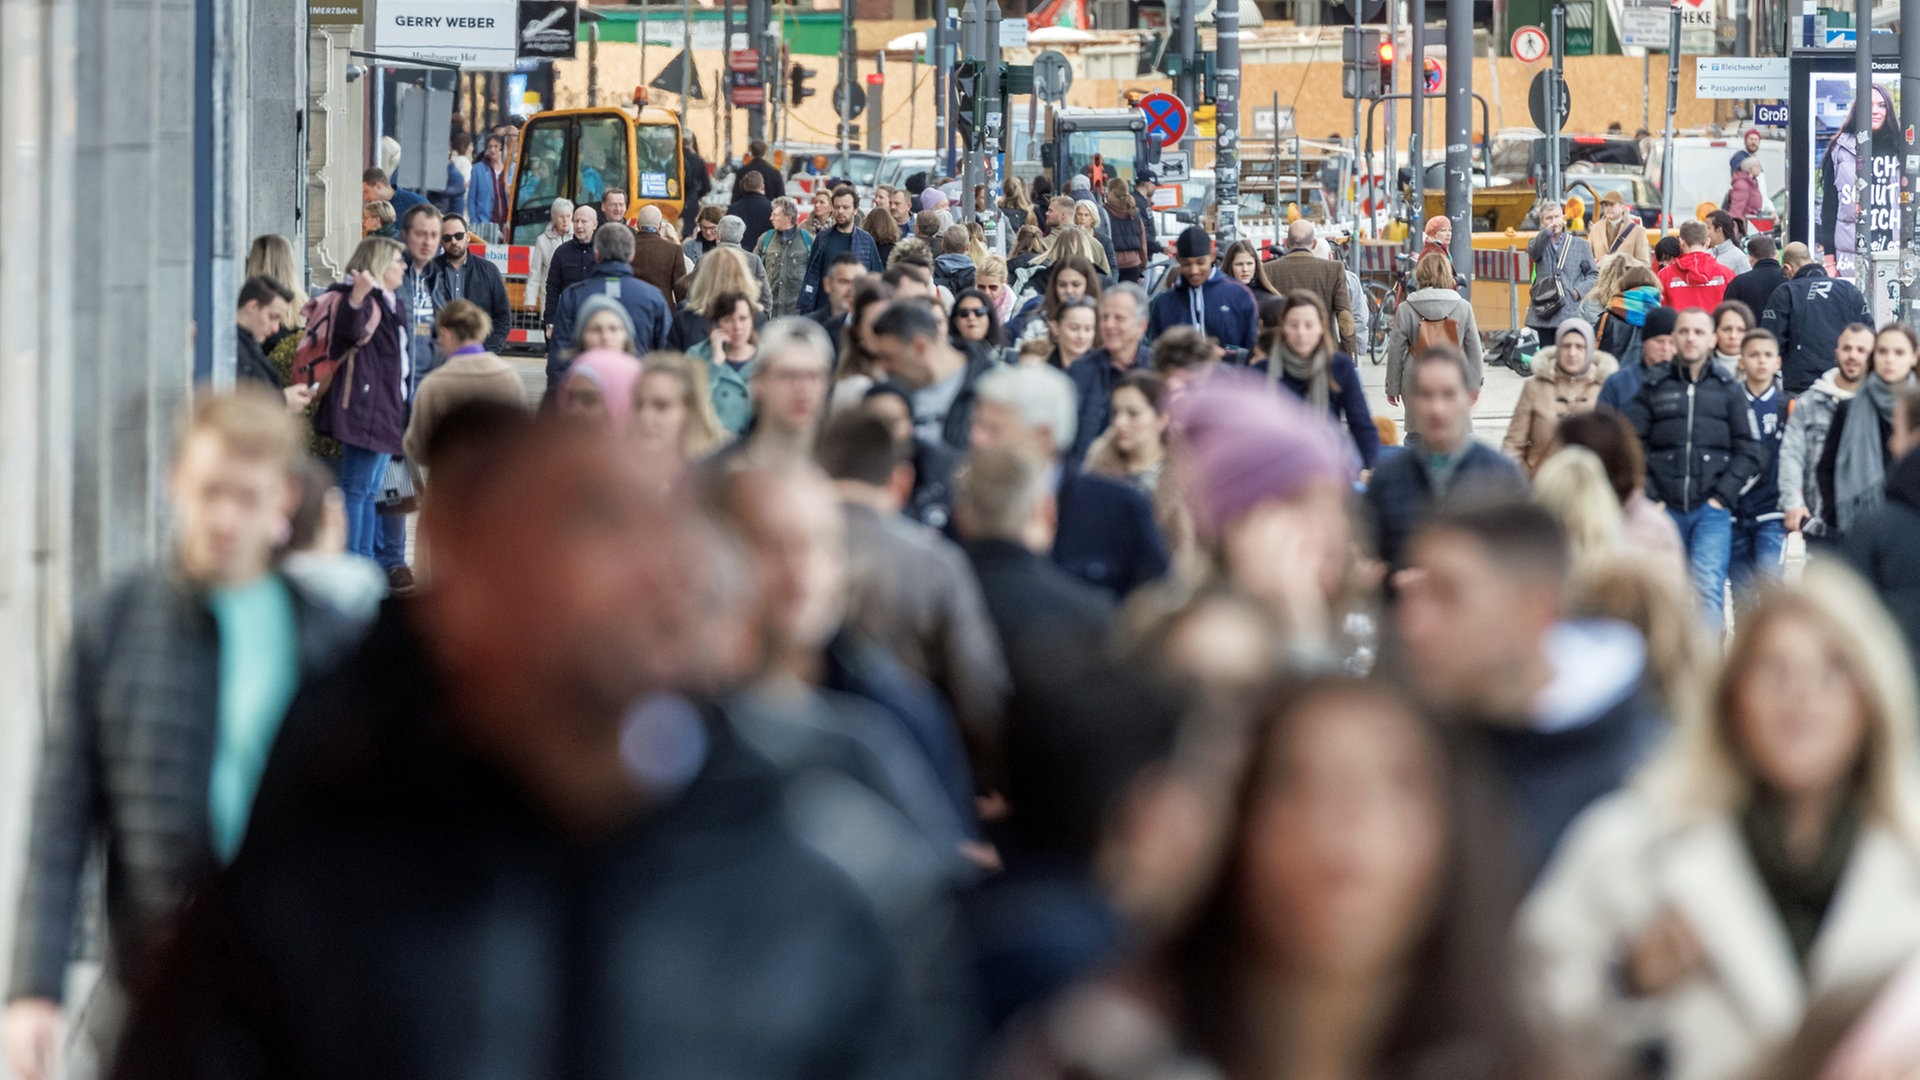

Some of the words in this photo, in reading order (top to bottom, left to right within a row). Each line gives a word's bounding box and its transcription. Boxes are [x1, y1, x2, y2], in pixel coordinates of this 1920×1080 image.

[395, 16, 441, 27] GERRY
[446, 18, 494, 28] WEBER
[461, 53, 477, 62] Hof
[1721, 63, 1763, 72] Bleichenhof
[1711, 84, 1766, 93] Passagenviertel
